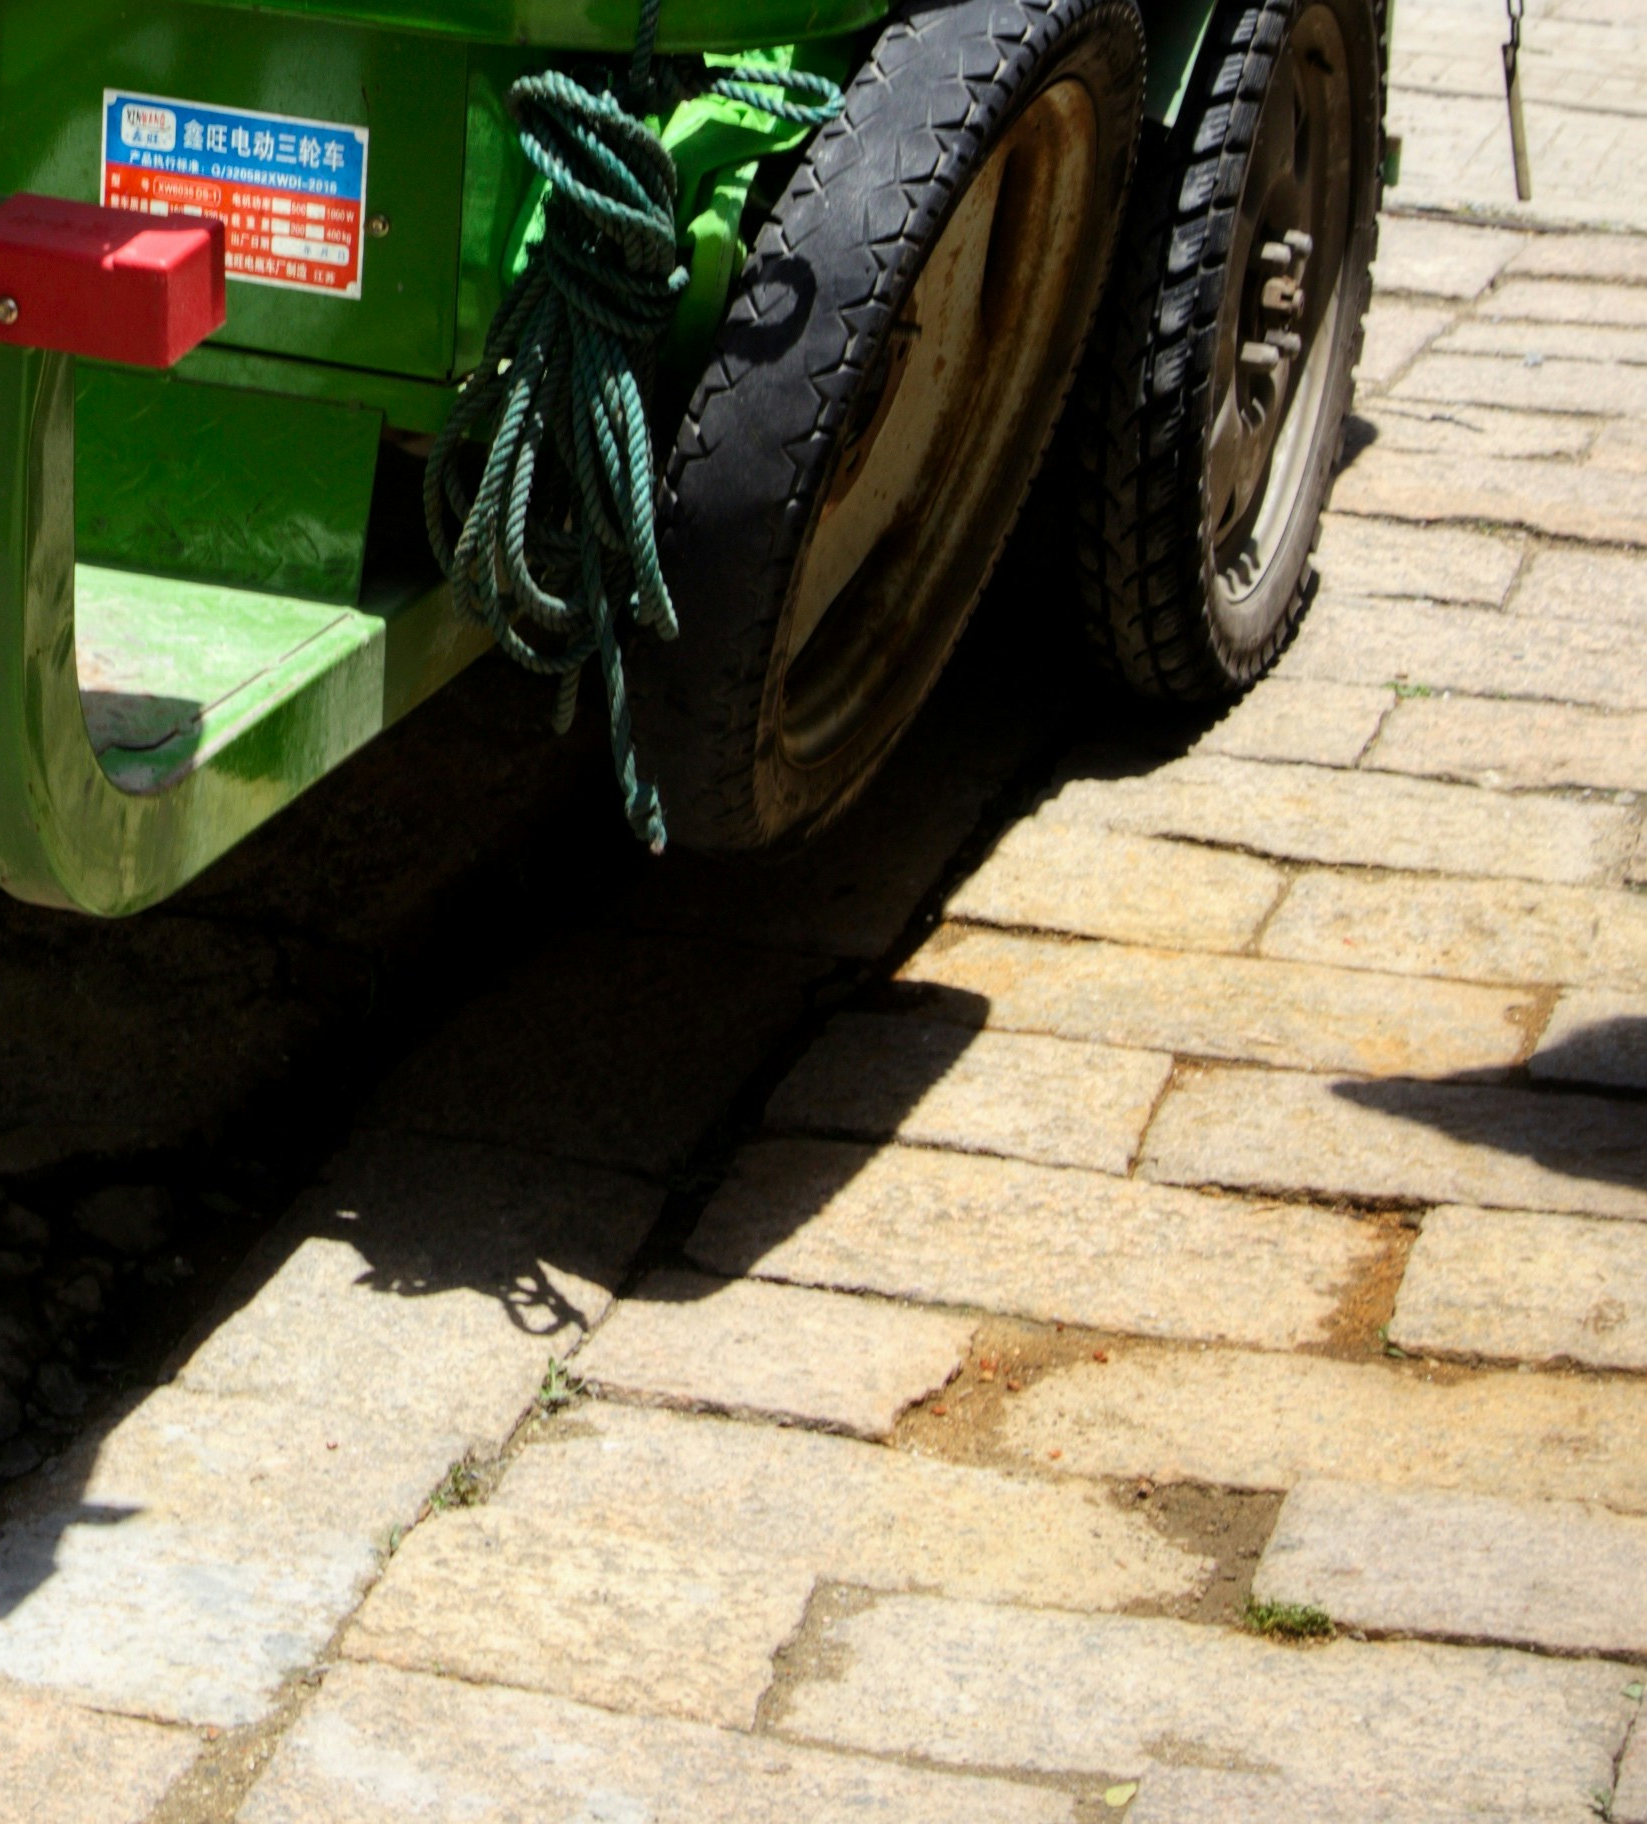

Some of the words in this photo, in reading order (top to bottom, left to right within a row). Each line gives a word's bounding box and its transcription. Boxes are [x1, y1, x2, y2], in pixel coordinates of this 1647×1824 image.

[183, 118, 345, 172] 鑫旺电动三轮车
